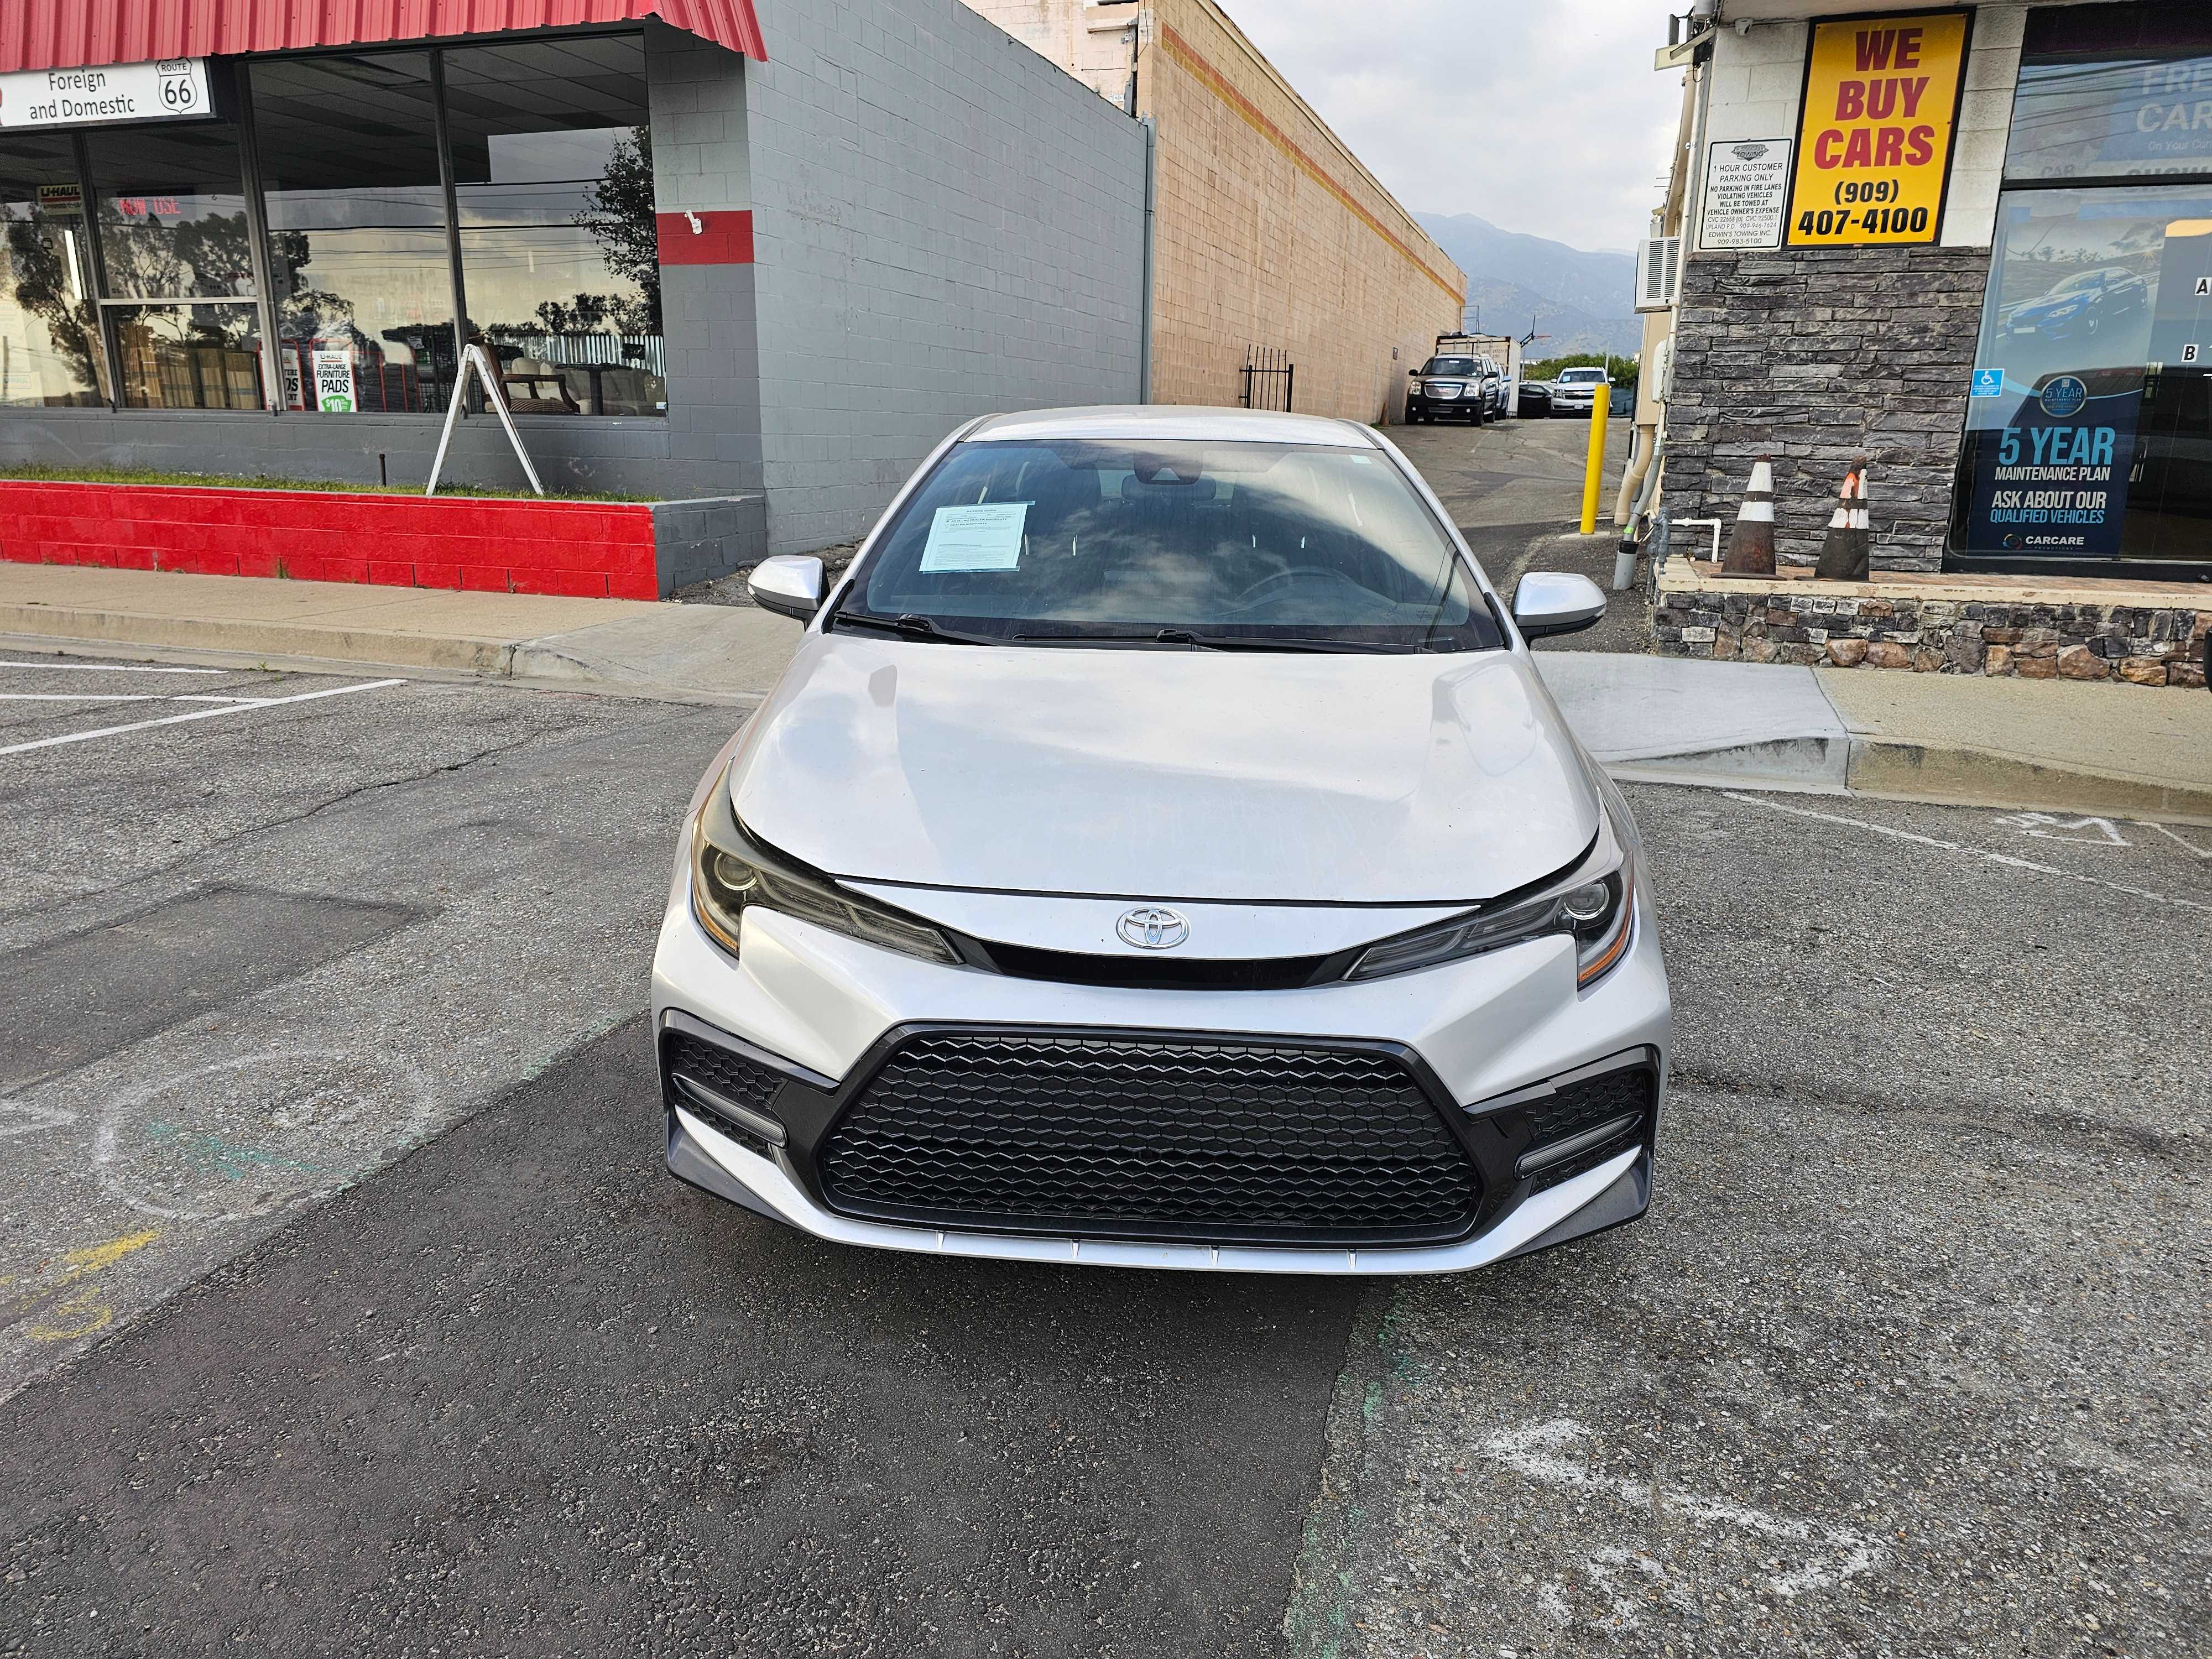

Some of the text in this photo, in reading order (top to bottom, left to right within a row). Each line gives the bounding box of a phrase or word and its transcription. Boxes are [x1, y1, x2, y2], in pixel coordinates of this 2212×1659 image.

[1856, 28, 1923, 71] WE
[161, 63, 187, 72] ROUTE
[49, 70, 106, 92] Foreign
[165, 79, 191, 104] 66
[1835, 77, 1931, 121] BUY
[30, 95, 135, 119] and Domestic
[1814, 125, 1935, 169] CARS
[1743, 163, 1783, 171] CUSTOMER
[1720, 173, 1774, 182] PARKING ONLY
[41, 186, 80, 197] U-HAUL
[1834, 179, 1899, 205] (909)
[1798, 207, 1928, 236] 407-4100
[2195, 279, 2208, 294] A
[2184, 346, 2196, 361] B
[317, 370, 350, 378] FURNITURE
[322, 379, 349, 393] PADS
[2046, 388, 2083, 398] 5 YEAR
[1999, 427, 2115, 465] 5 YEAR
[1995, 467, 2111, 481] MAINTENANCE PLAN
[1991, 491, 2107, 509] ASK ABOUT OUR
[1990, 509, 2105, 524] QUALIFIED VEHICLES
[2025, 536, 2084, 545] CARCARE
